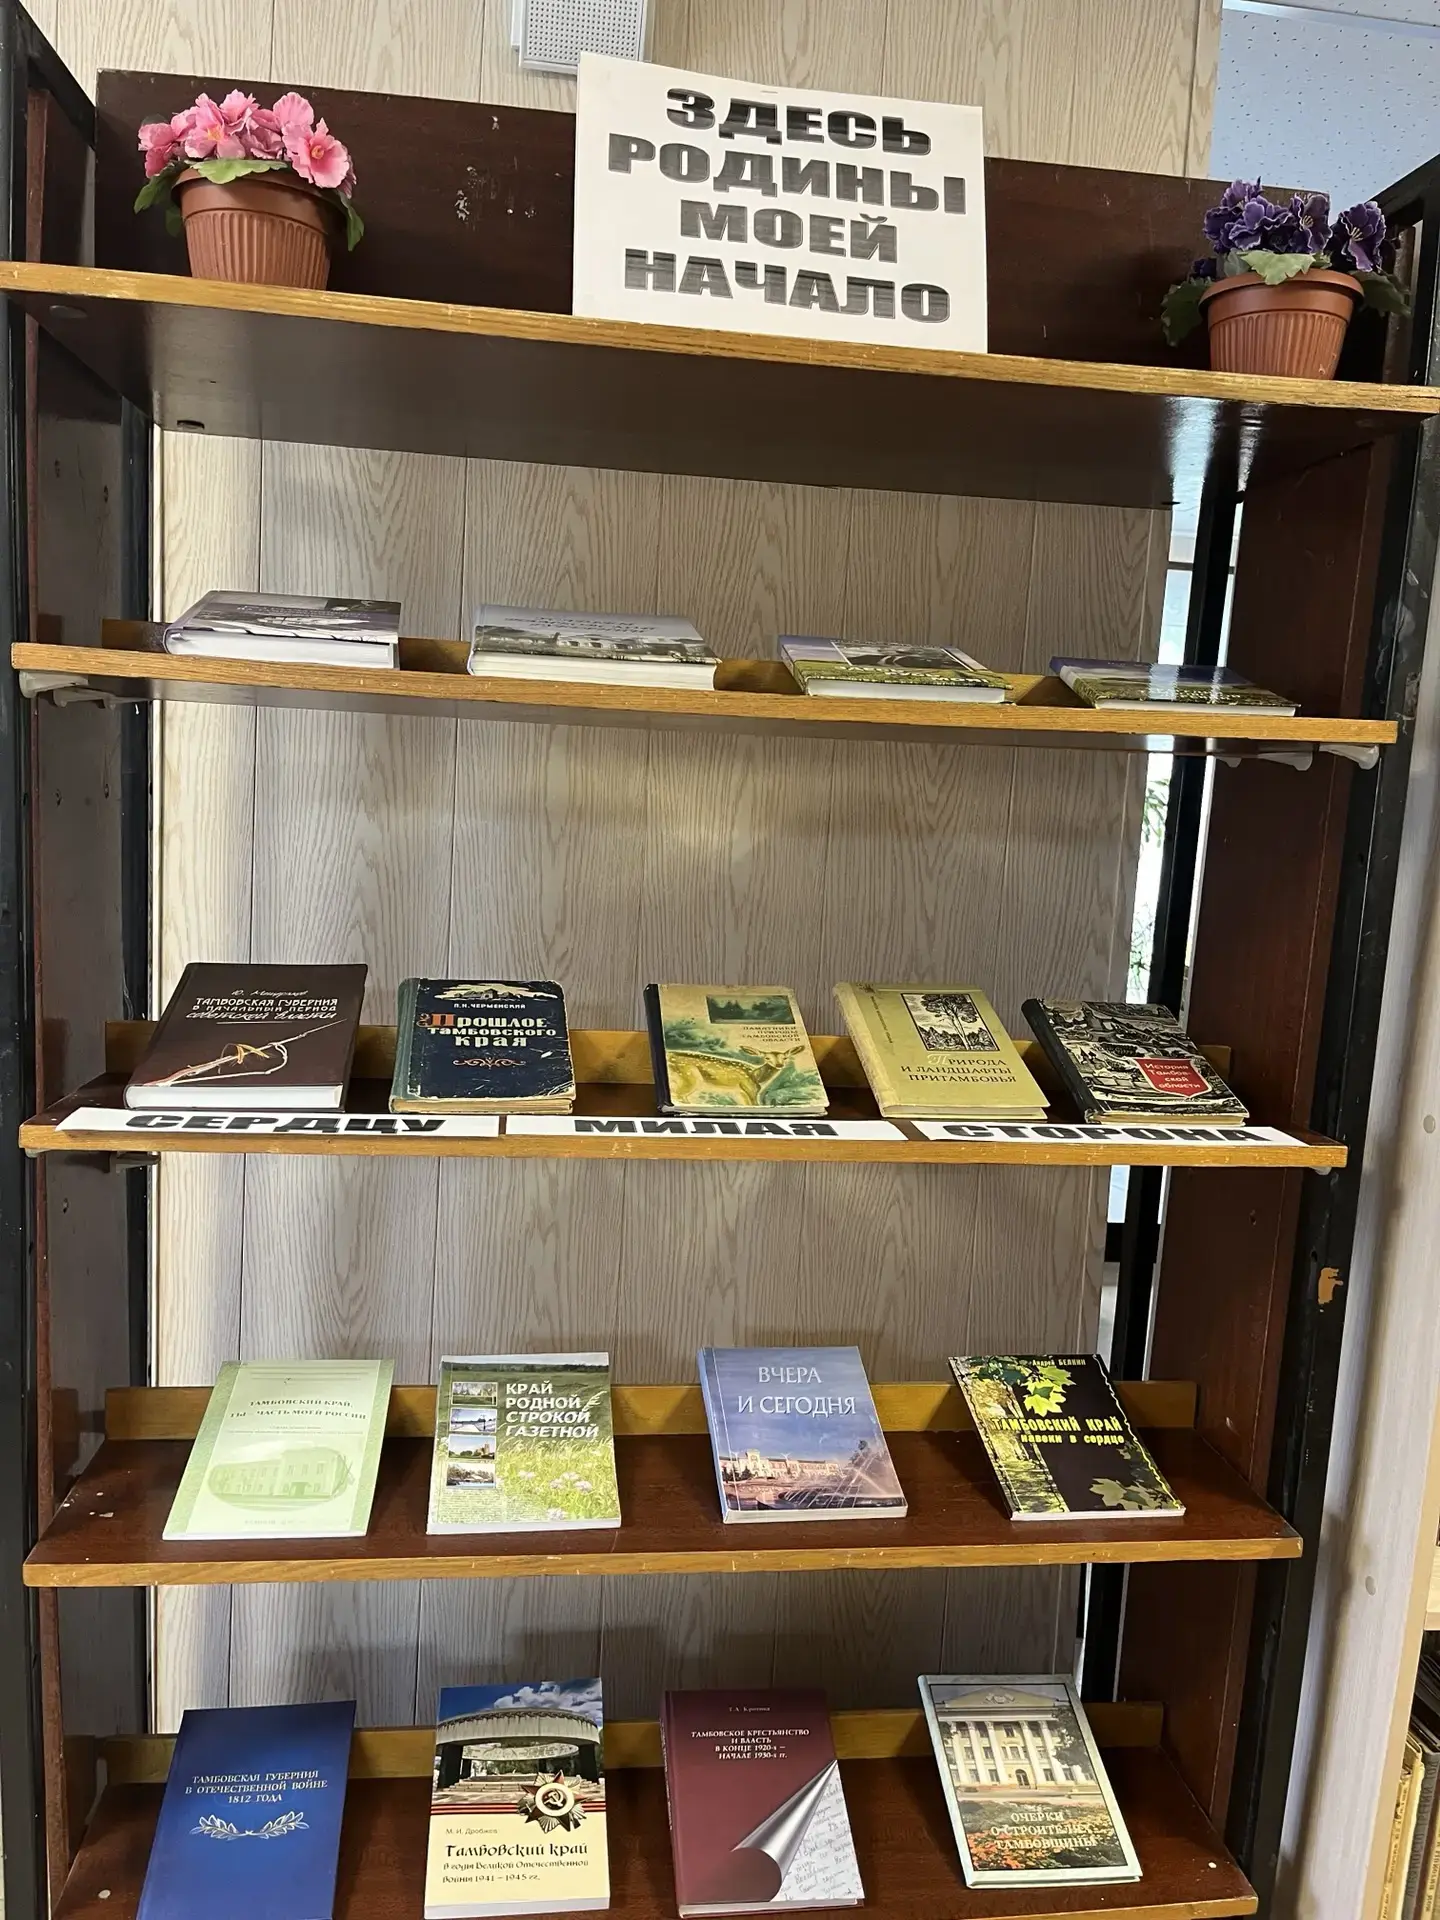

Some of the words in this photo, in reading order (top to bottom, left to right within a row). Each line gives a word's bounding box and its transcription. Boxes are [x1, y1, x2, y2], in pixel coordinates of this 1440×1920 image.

[665, 87, 931, 156] ЗДЕСЬ
[608, 133, 966, 215] РОДИНЫ
[680, 200, 898, 263] МОЕЙ
[624, 248, 951, 324] НАЧАЛО
[196, 997, 274, 1006] ТАМБОВСКАЯ
[278, 998, 338, 1006] ГУБЕРНИЯ
[916, 1065, 1012, 1075] ЛАНДШАФТЫ
[909, 1074, 1017, 1083] ПРИТАМБОВЬЯ
[125, 1114, 447, 1134] СЕРДЦУ
[574, 1119, 839, 1137] МИЛАЯ
[942, 1124, 1272, 1142] СТОРОНА
[1058, 1358, 1087, 1366] БЕЛКИН
[758, 1366, 823, 1384] ВЧЕРА
[505, 1380, 554, 1395] КРАЙ
[250, 1399, 322, 1407] ТАМБОВСКИЙ
[505, 1394, 582, 1411] РОДНОЙ
[738, 1395, 754, 1414] И
[759, 1395, 856, 1419] СЕГОДНЯ
[292, 1408, 322, 1416] МОЕЙ
[325, 1410, 367, 1420] РОССИИ
[505, 1409, 591, 1424] СТРОКОЙ
[992, 1415, 1081, 1432] ТАМБОВСКИЙ
[1085, 1415, 1123, 1432] КРАЙ
[505, 1423, 600, 1439] ГАЗЕТНОЙ
[1020, 1434, 1063, 1444] навеки
[1069, 1434, 1078, 1444] в
[1083, 1434, 1125, 1446] сердце
[691, 1730, 745, 1738] ТАМБОВСКОЕ
[747, 1729, 810, 1737] КРЕСТЬЯНСТВО
[722, 1745, 752, 1753] КОНЦЕ
[754, 1744, 777, 1752] 1920-х
[719, 1752, 752, 1760] НАЧАЛЕ
[192, 1774, 261, 1784] ТАМБОВСКАЯ
[265, 1770, 319, 1781] ГУБЕРНИЯ
[185, 1786, 192, 1794] В
[197, 1781, 287, 1794] ОТЕЧЕСТВЕННОЙ
[291, 1779, 328, 1790] ВОЙНЕ
[228, 1795, 251, 1804] 1812
[256, 1793, 282, 1803] ГОДА
[1010, 1811, 1066, 1823] ОЧЕРКИ
[445, 1827, 453, 1835] М.
[465, 1827, 498, 1836] Дробжев
[990, 1826, 1000, 1836] О
[1004, 1824, 1093, 1836] СТРОИТЕЛЯХ
[994, 1836, 1099, 1850] ТАМБОВЩИНЫ
[445, 1843, 545, 1858] Тамбовский
[549, 1842, 588, 1858] край
[450, 1863, 474, 1872] годы
[475, 1861, 514, 1871] Великой
[515, 1859, 589, 1869] Отечественной
[475, 1874, 495, 1883] 1941
[505, 1873, 527, 1882] 1945
